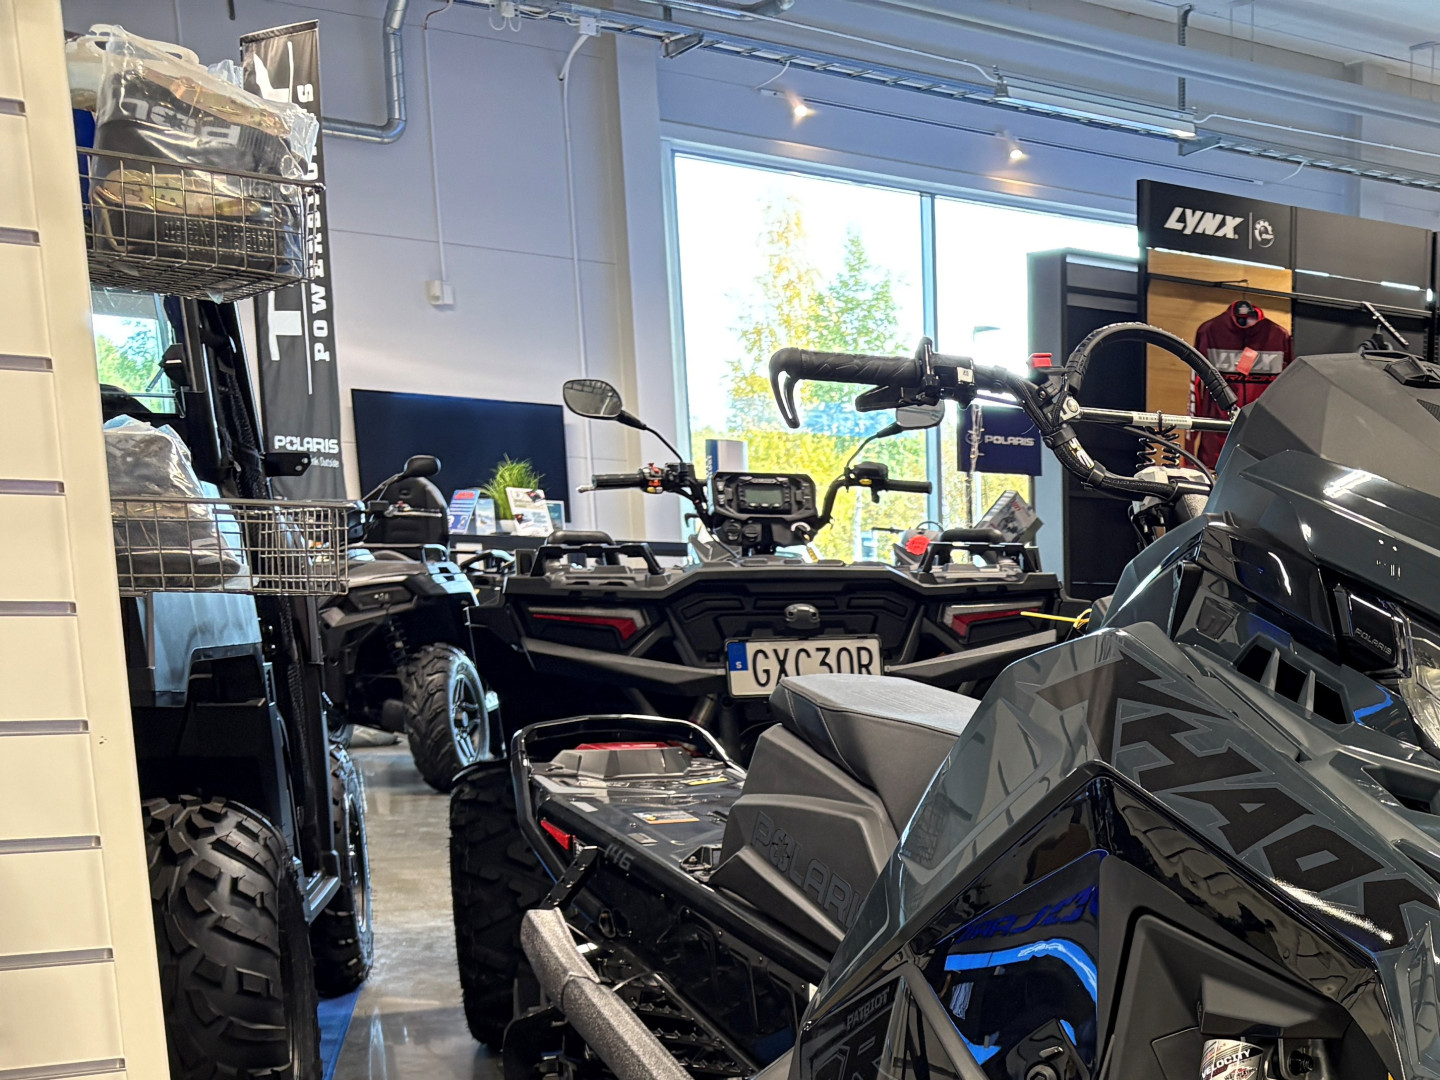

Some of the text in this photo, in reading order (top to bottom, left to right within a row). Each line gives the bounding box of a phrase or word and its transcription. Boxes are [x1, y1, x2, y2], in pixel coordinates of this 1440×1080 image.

[1163, 206, 1244, 239] LYNX
[1215, 352, 1278, 372] LYX
[273, 435, 340, 454] POLARIS
[984, 434, 1036, 447] POLARIS
[1354, 627, 1393, 656] POLARIS
[735, 661, 743, 669] S
[1036, 653, 1434, 945] KHAOS
[750, 811, 863, 931] POLARI
[845, 989, 891, 1032] PATRIOT
[1201, 1049, 1251, 1079] VELOCITY
